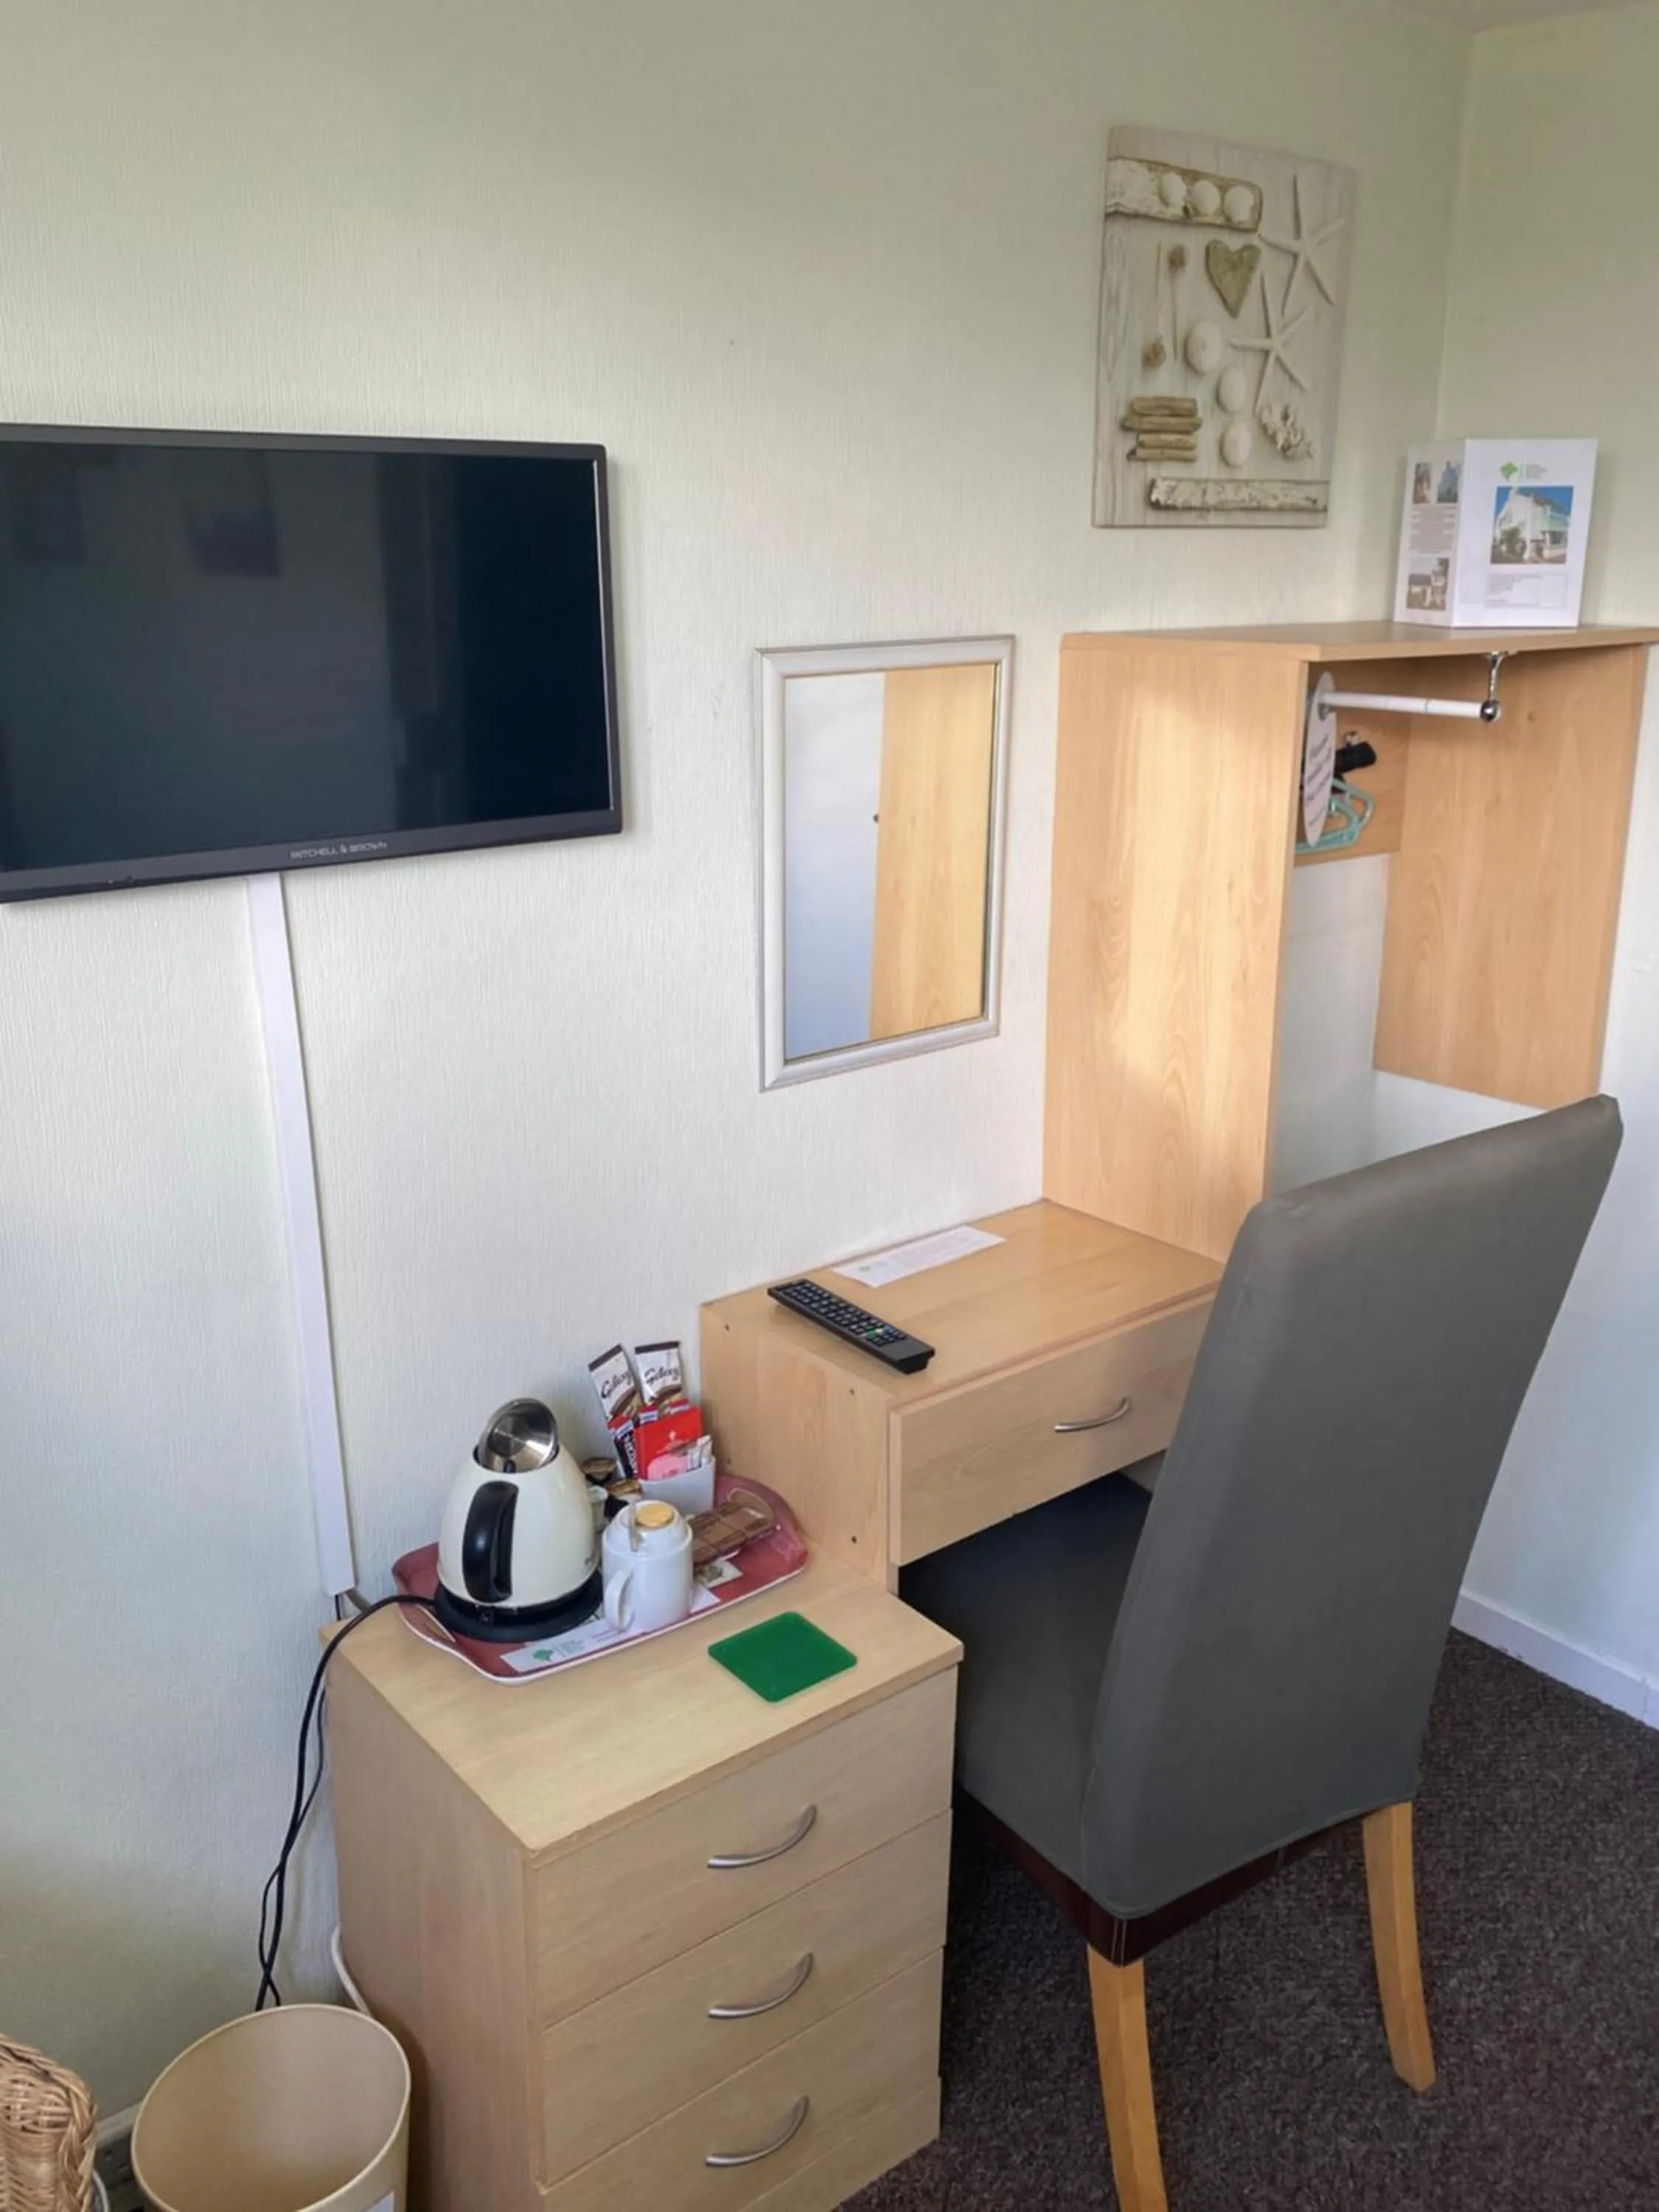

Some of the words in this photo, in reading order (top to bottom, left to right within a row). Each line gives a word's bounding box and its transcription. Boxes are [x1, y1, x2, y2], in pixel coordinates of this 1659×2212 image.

[290, 846, 338, 860] MITCHELL
[340, 843, 349, 854] &
[349, 841, 388, 853] BROWN
